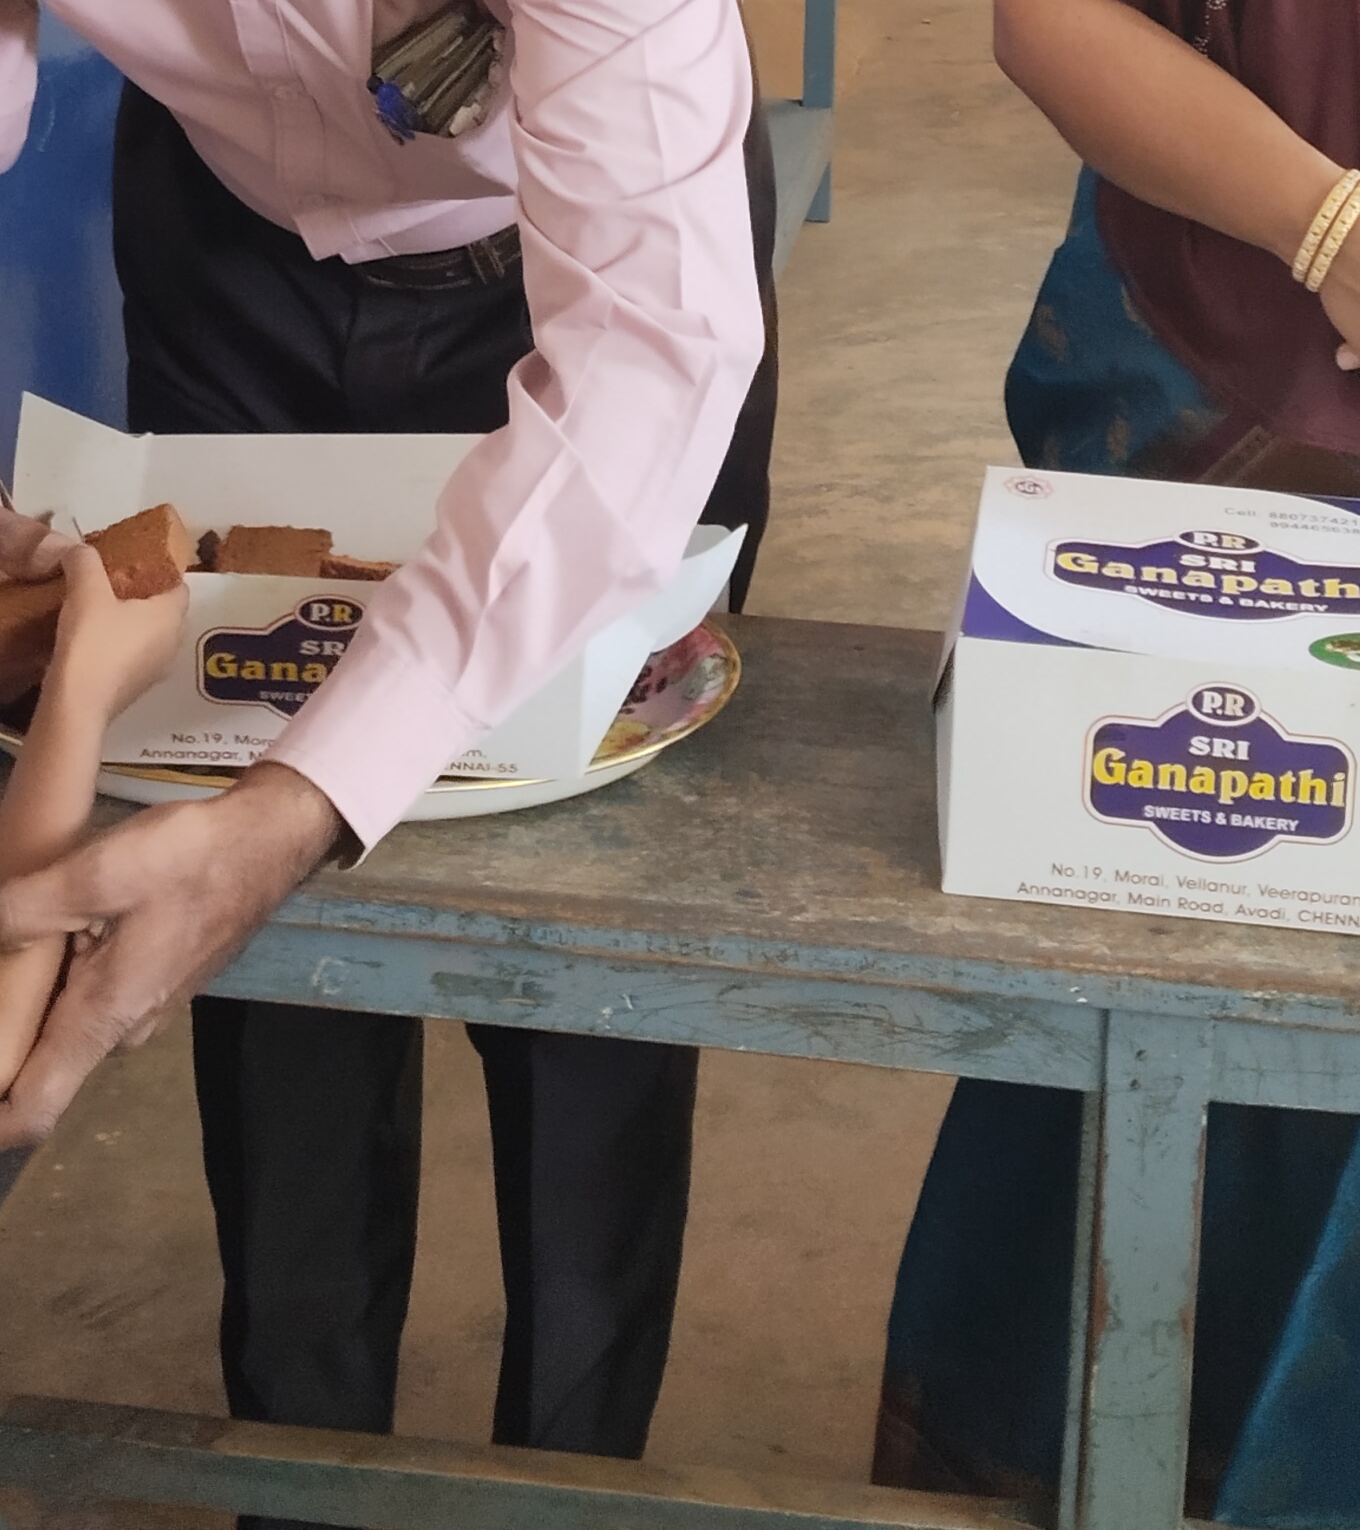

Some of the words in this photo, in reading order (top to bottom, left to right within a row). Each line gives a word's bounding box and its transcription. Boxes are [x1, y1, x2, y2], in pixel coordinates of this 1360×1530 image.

[1179, 553, 1256, 573] SRI
[1123, 585, 1214, 603] SWEETS
[1218, 596, 1234, 605] &
[1239, 596, 1329, 613] BAKERY
[310, 602, 354, 623] P.R
[299, 640, 346, 656] SR
[206, 652, 334, 682] Gana
[259, 691, 313, 702] SWEE
[1199, 689, 1246, 718] P.R
[171, 733, 228, 747] No.19,
[1189, 735, 1250, 761] SRI
[140, 748, 242, 762] Annanagar,
[446, 761, 518, 774] NNAI-55
[1093, 747, 1346, 809] Ganapathi
[1143, 804, 1212, 825] SWEETS
[1215, 811, 1228, 826] &
[1231, 814, 1299, 834] BAKERY
[1051, 861, 1108, 882] No.19,
[1115, 869, 1169, 888] Morai,
[1176, 874, 1251, 896] Vellanur,
[1016, 881, 1121, 905] Annanagar,
[1128, 892, 1171, 908] Main
[1178, 897, 1230, 916] Road,
[1235, 902, 1291, 922] Avadi,
